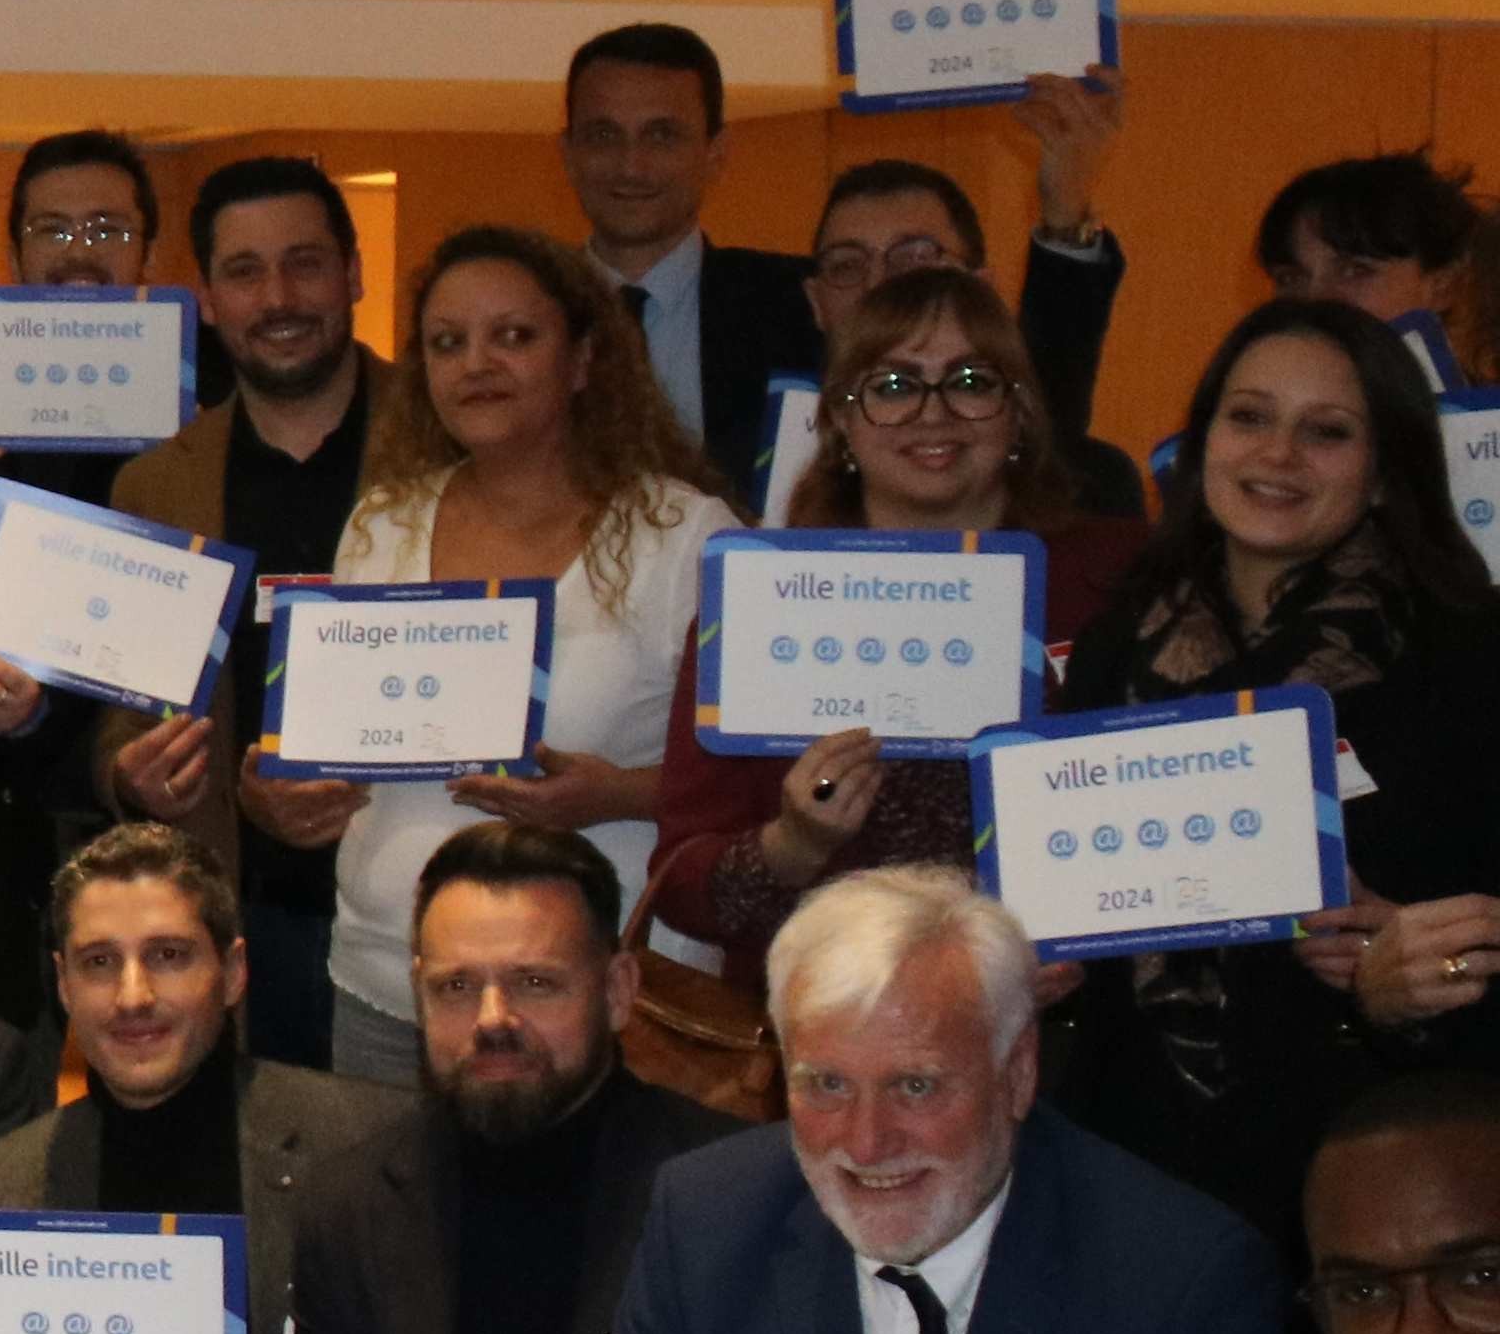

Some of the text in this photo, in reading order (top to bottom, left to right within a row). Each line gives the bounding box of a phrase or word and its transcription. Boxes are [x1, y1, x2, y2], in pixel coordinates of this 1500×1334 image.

[2, 318, 143, 338] ville internet
[31, 408, 69, 423] 2024
[1467, 432, 1500, 460] vil
[774, 572, 973, 604] ville internet
[317, 619, 509, 651] village internet
[811, 697, 866, 717] 2024
[359, 728, 404, 746] 2024
[1044, 741, 1255, 792] ville internet
[1097, 886, 1154, 913] 2024
[46, 1252, 173, 1282] internet
